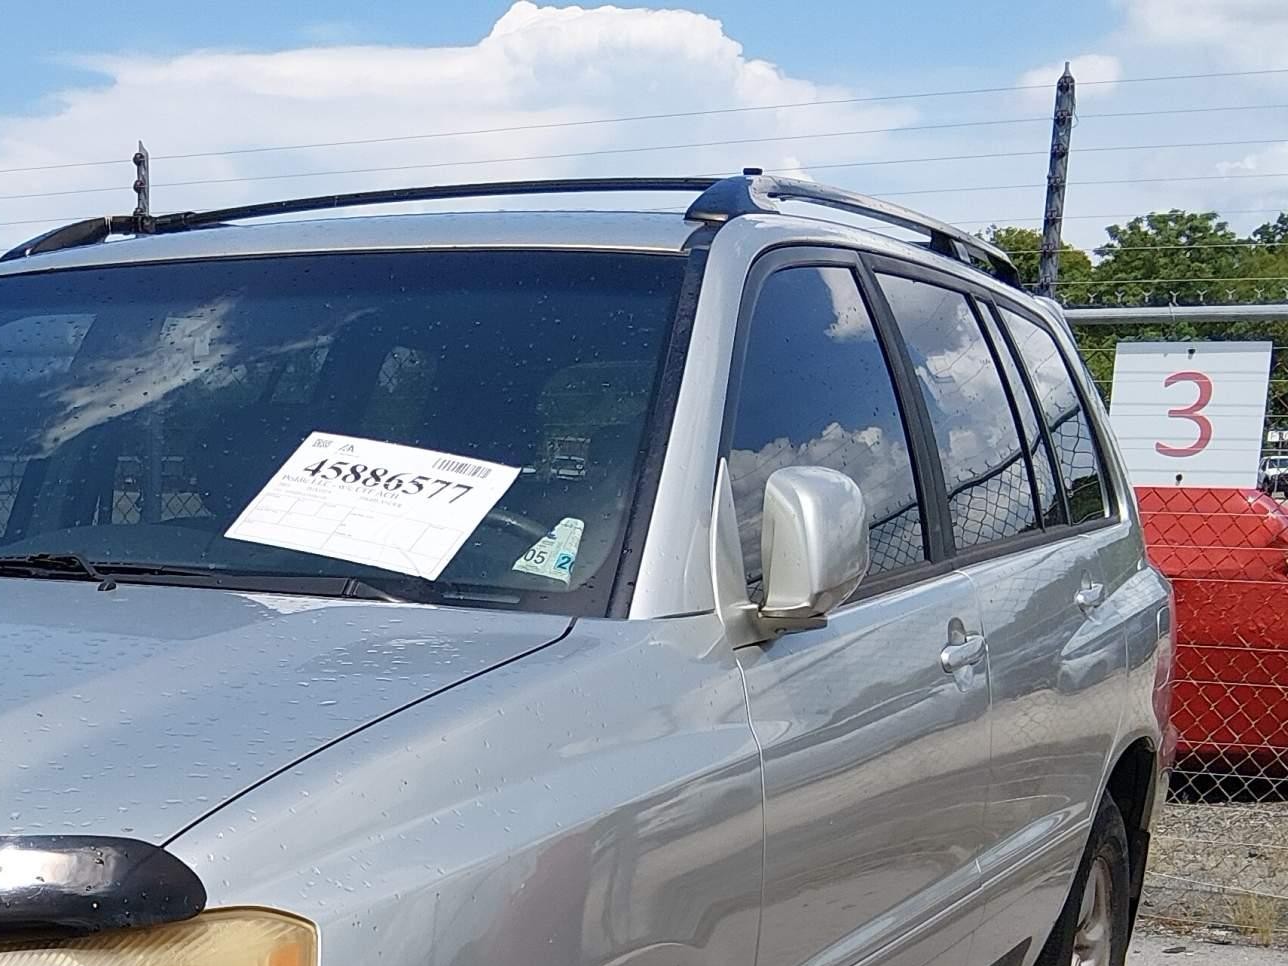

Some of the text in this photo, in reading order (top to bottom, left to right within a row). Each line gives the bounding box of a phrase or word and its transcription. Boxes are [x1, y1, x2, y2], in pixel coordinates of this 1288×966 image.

[1155, 371, 1214, 458] 3
[303, 458, 474, 504] 45886577
[523, 548, 548, 565] 05
